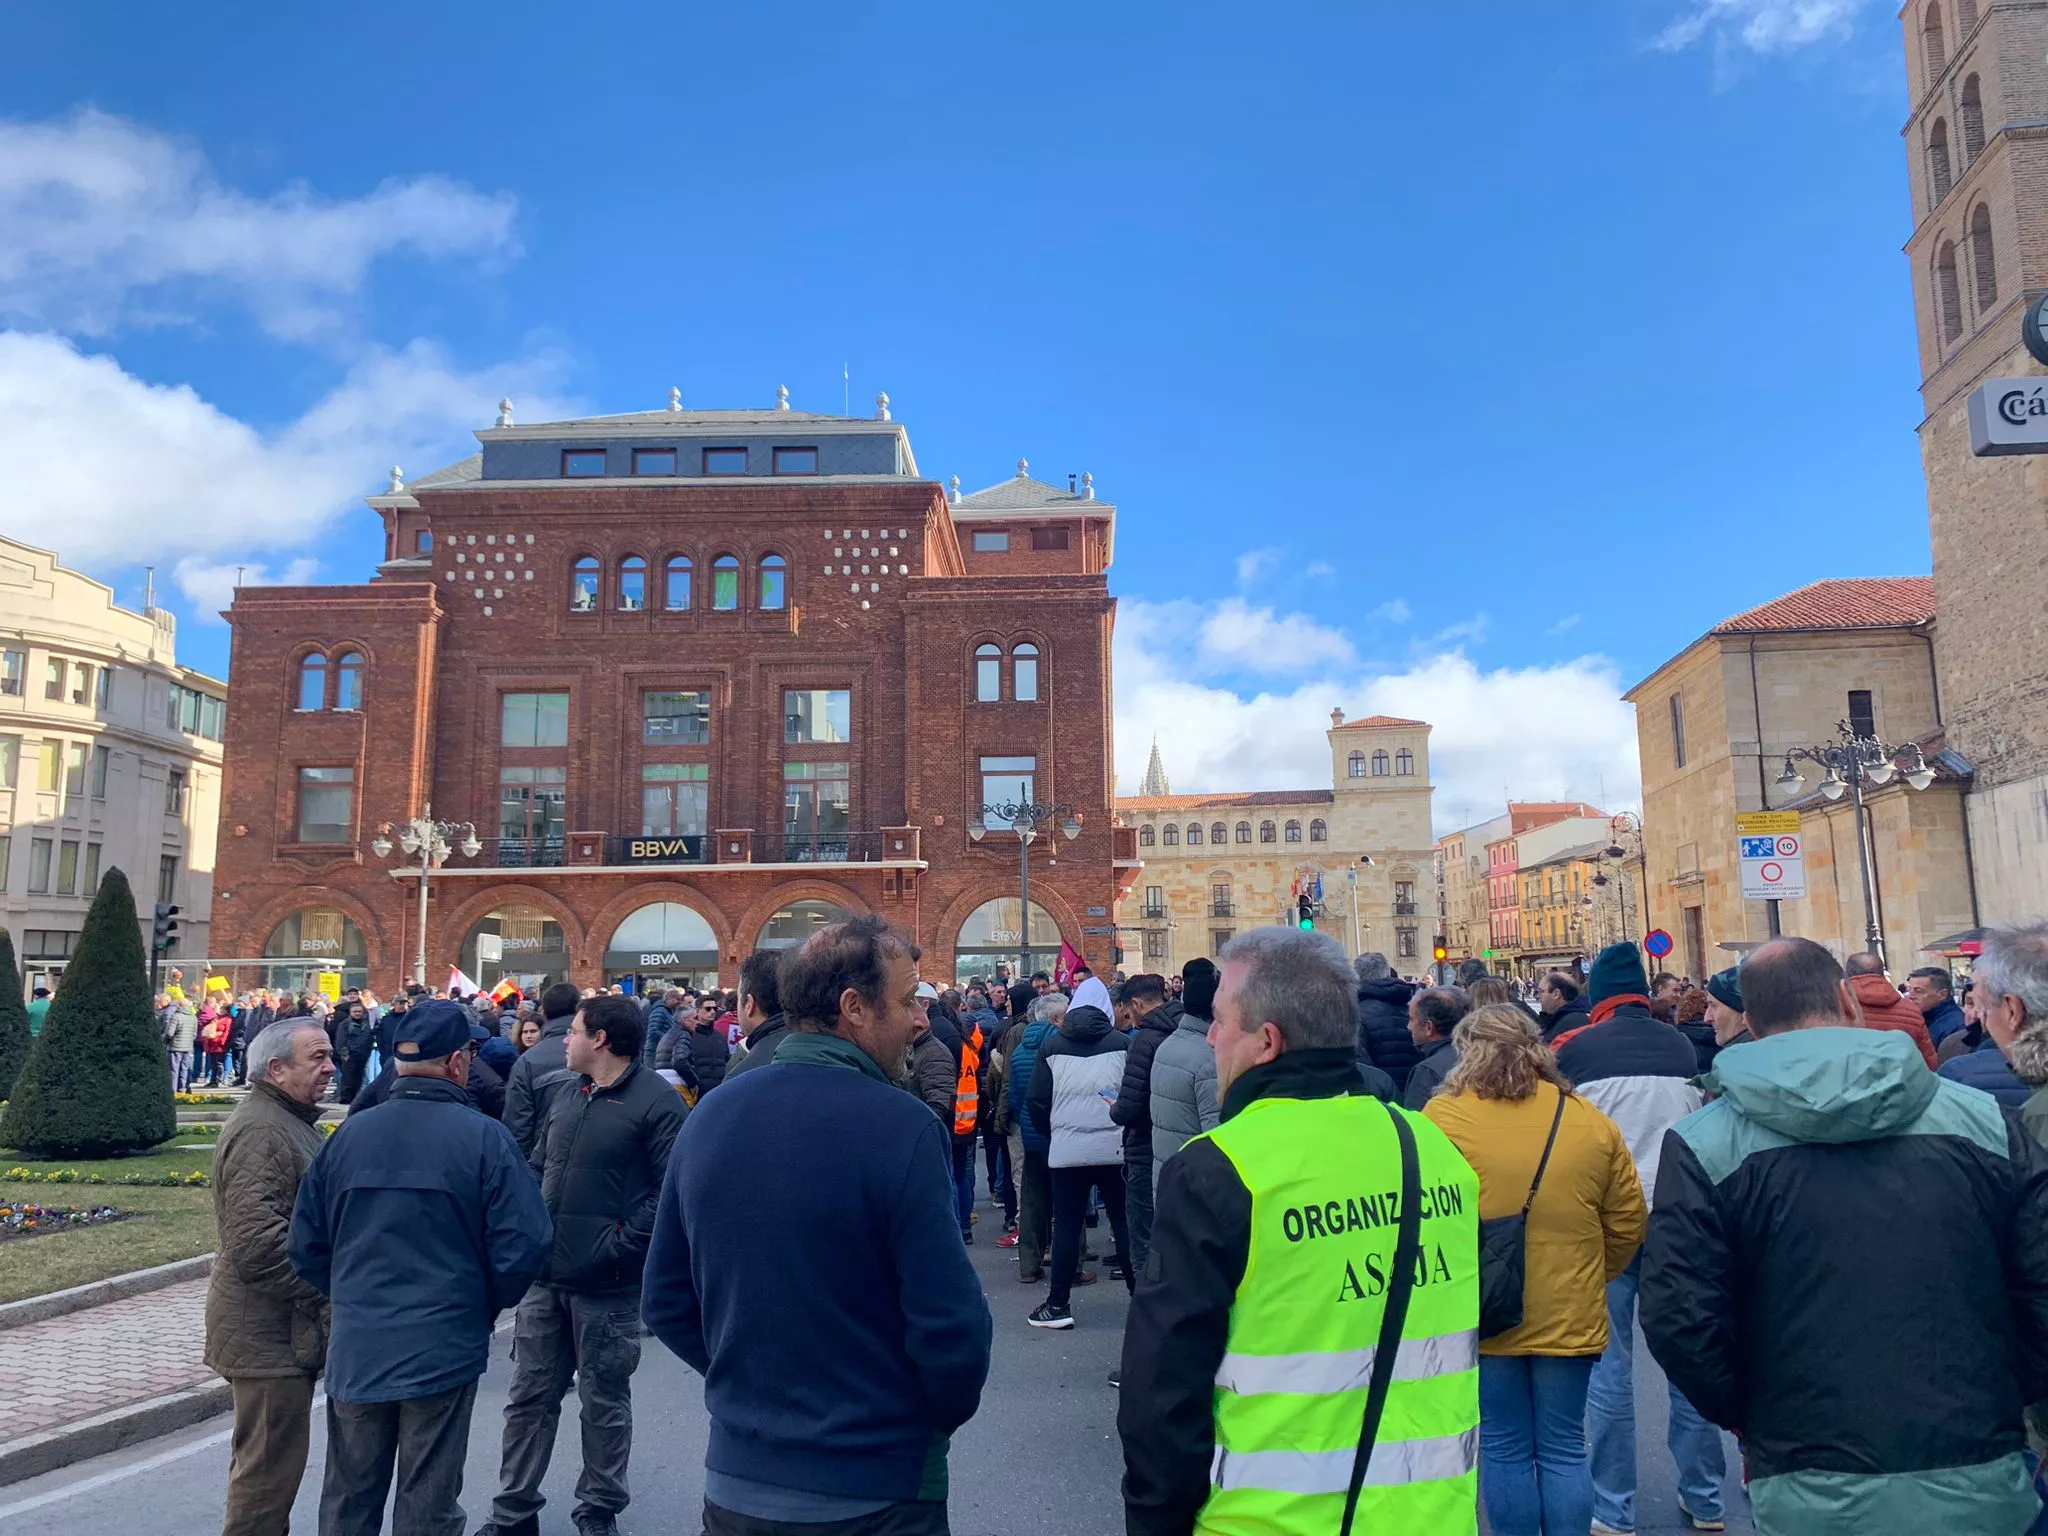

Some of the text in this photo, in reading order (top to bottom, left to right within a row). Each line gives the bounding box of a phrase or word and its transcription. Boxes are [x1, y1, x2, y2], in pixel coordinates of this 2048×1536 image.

[631, 839, 689, 858] BBVA
[1781, 842, 1793, 850] 10
[302, 939, 339, 951] BBVA
[502, 937, 539, 950] BBVA
[640, 953, 679, 966] BBVA
[1282, 1178, 1463, 1242] ORGANIZCIÓN
[1336, 1242, 1452, 1303] ASJA
